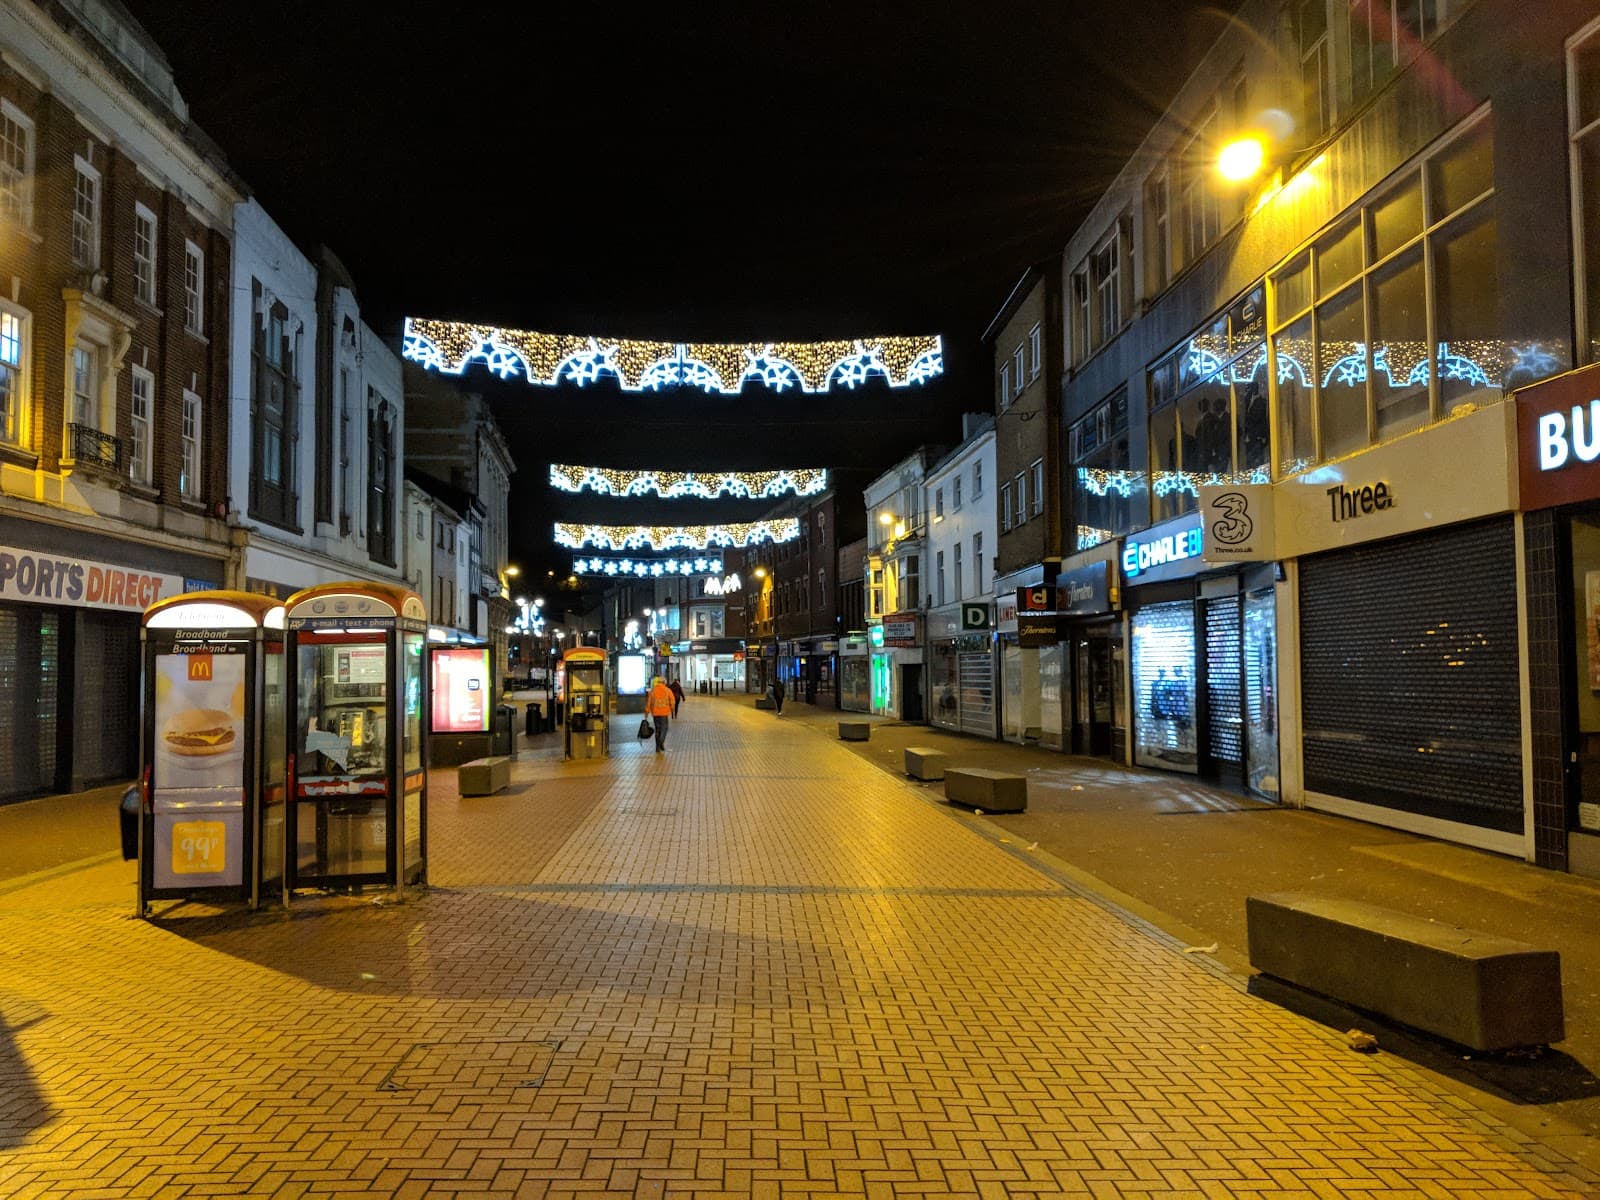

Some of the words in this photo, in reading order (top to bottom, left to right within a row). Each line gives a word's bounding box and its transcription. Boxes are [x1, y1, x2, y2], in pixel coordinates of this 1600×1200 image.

[85, 566, 162, 609] DIRECT
[967, 607, 985, 625] D
[175, 630, 229, 639] Broadband
